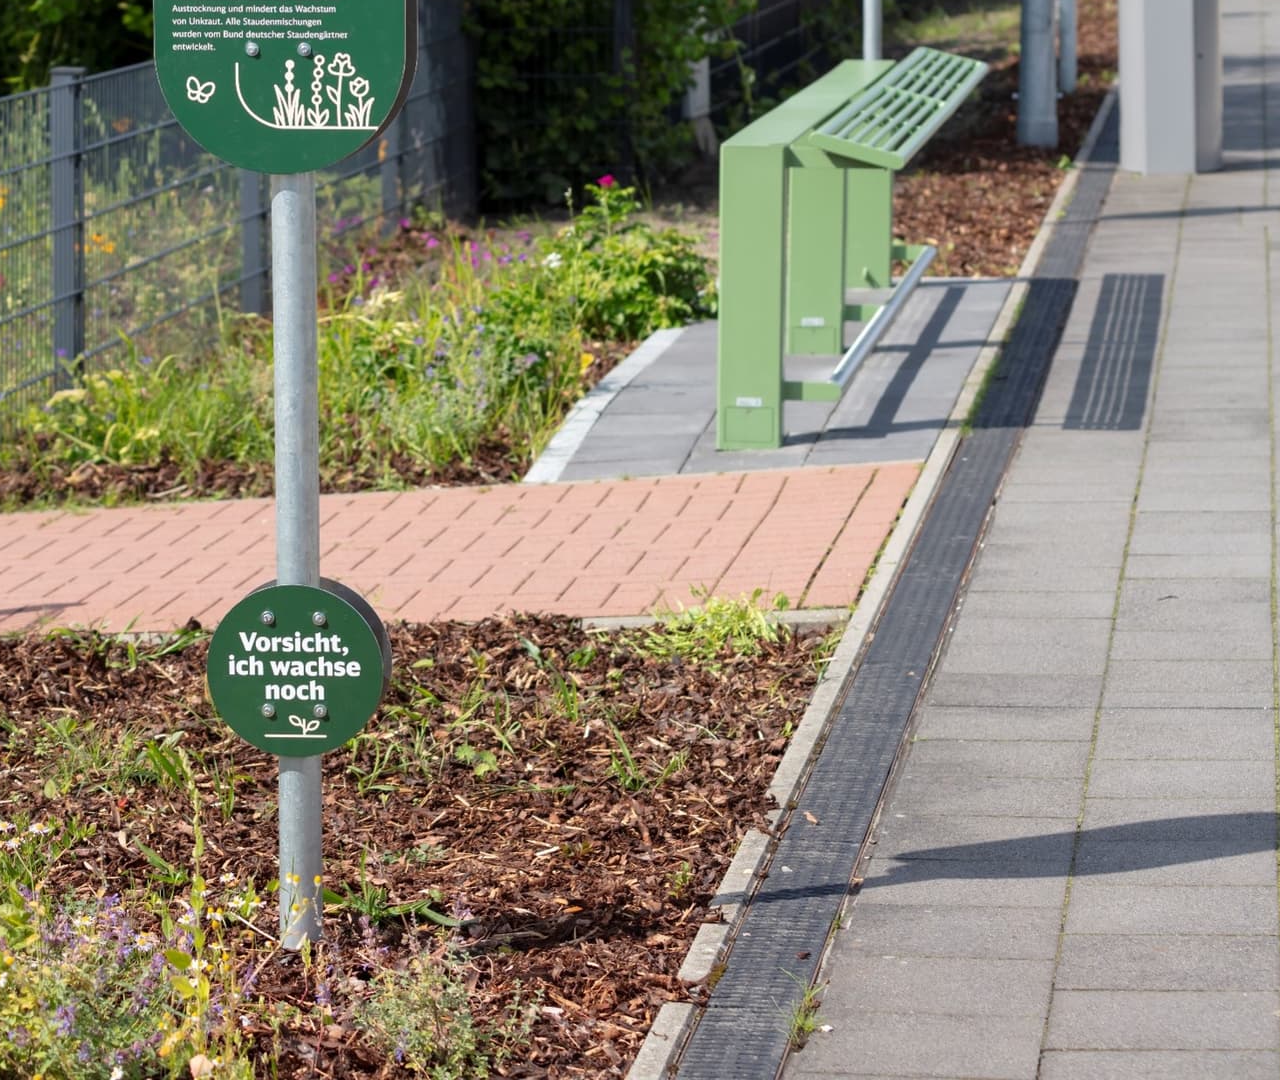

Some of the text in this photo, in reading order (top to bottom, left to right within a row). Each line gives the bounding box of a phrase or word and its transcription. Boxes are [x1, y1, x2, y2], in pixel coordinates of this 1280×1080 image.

[172, 4, 336, 15] Austrocknung und mindert das Wachstum
[172, 16, 322, 28] von Unkraut. Alle Staudenmischungen
[172, 29, 348, 41] wurden vom Bund deutscher Staudengärtner
[173, 42, 215, 52] entwickelt.
[238, 631, 348, 656] Vorsicht,
[229, 654, 361, 677] ich wachse
[266, 679, 324, 701] noch
